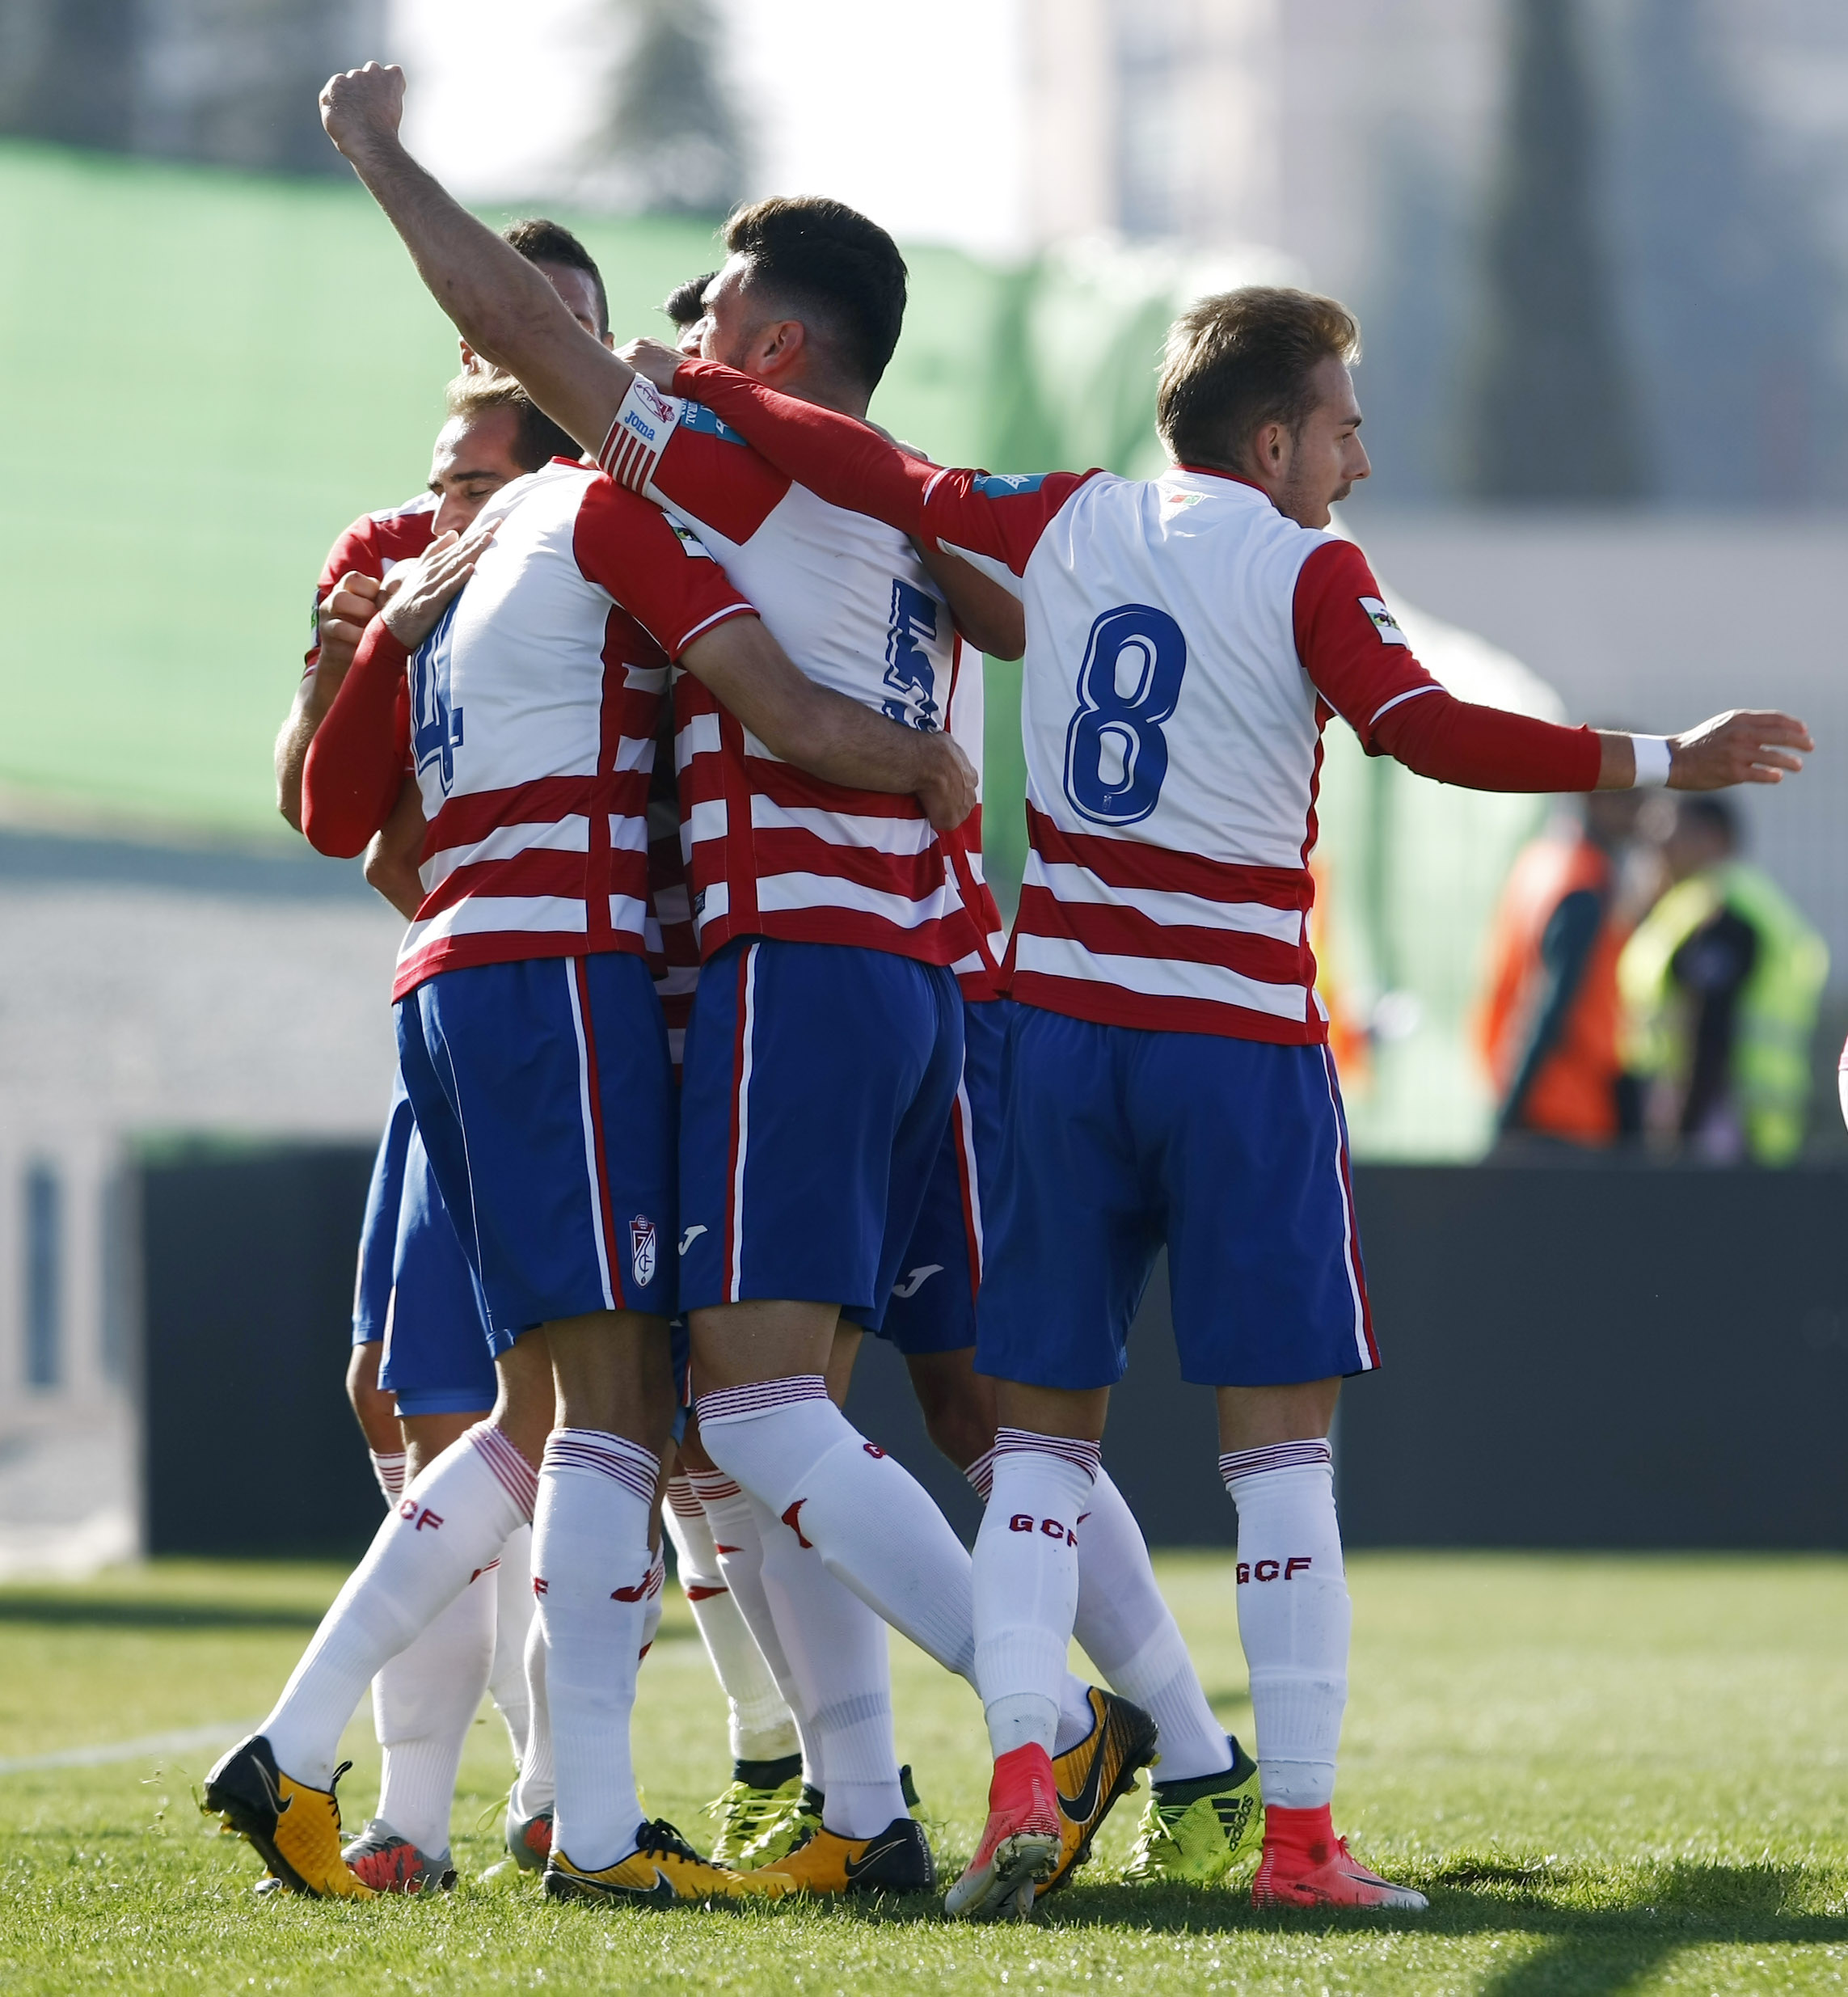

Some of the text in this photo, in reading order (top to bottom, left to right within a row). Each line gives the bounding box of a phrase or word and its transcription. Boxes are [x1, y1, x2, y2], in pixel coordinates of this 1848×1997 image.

[411, 579, 467, 798] 4
[882, 577, 940, 734] 5
[1062, 603, 1187, 827] 8
[399, 1498, 445, 1532] CF
[1235, 1556, 1312, 1585] GCF
[1229, 1793, 1255, 1852] adidas
